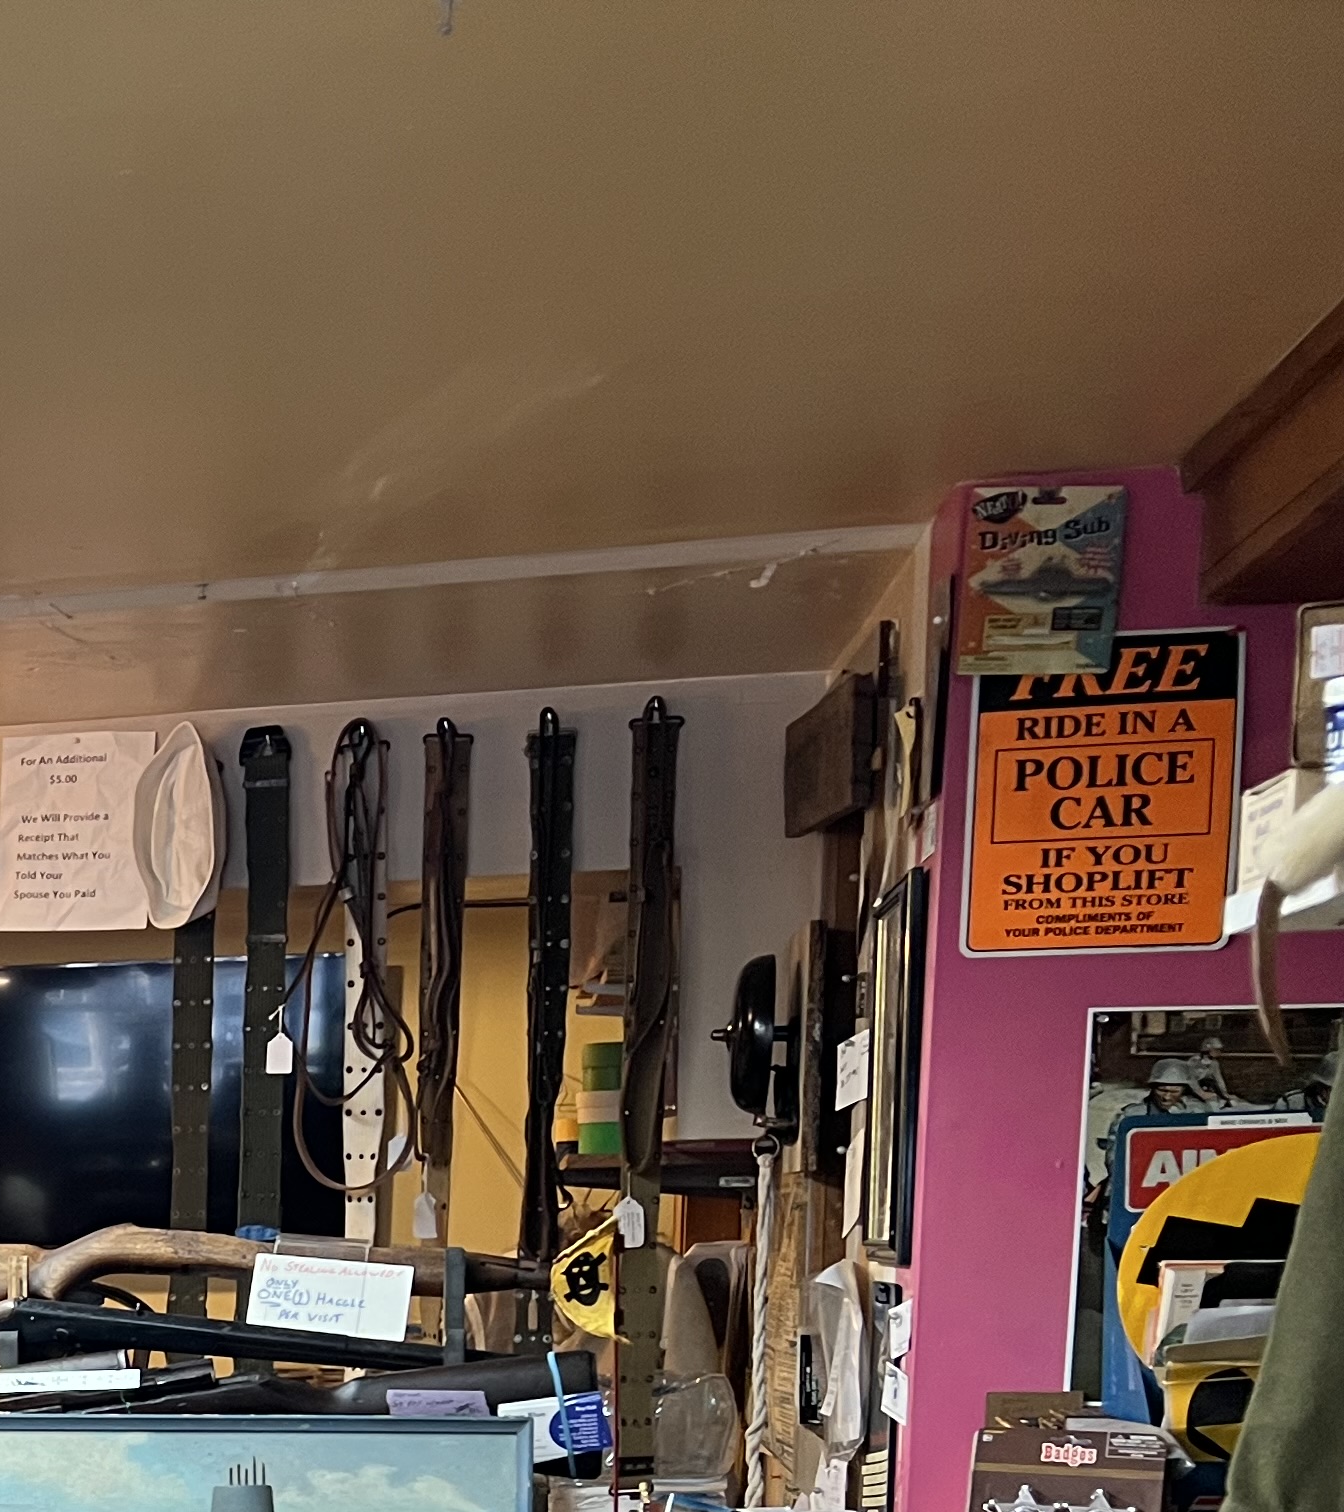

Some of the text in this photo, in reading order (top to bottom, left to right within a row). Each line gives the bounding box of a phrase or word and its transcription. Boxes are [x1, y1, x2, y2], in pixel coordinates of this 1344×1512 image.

[979, 516, 1111, 551] Diving Sub
[1015, 708, 1197, 741] RIDE IN A
[20, 753, 108, 767] For An Additional
[49, 773, 78, 785] $5.00
[1013, 750, 1195, 792] POLICE
[21, 811, 109, 824] We Will Provide a
[1049, 793, 1154, 831] CAR
[17, 832, 80, 844] Receipt That
[16, 850, 111, 861] Matches What You
[1040, 843, 1170, 868] IF YOU
[14, 870, 63, 881] Told Your
[1001, 867, 1195, 896] SHOPLIFT
[13, 888, 96, 901] Spouse You Paid
[1003, 892, 1190, 911] FROM THIS STORE
[1035, 910, 1155, 925] COMPLIMENTS OF
[1004, 922, 1185, 938] YOUR POLICE DEPARTMENT
[1141, 1149, 1231, 1188] AI
[265, 1277, 299, 1289] ONLY
[315, 1292, 366, 1309] HAGGLE
[277, 1308, 344, 1324] PER VISIT
[1042, 1444, 1096, 1464] Badges
